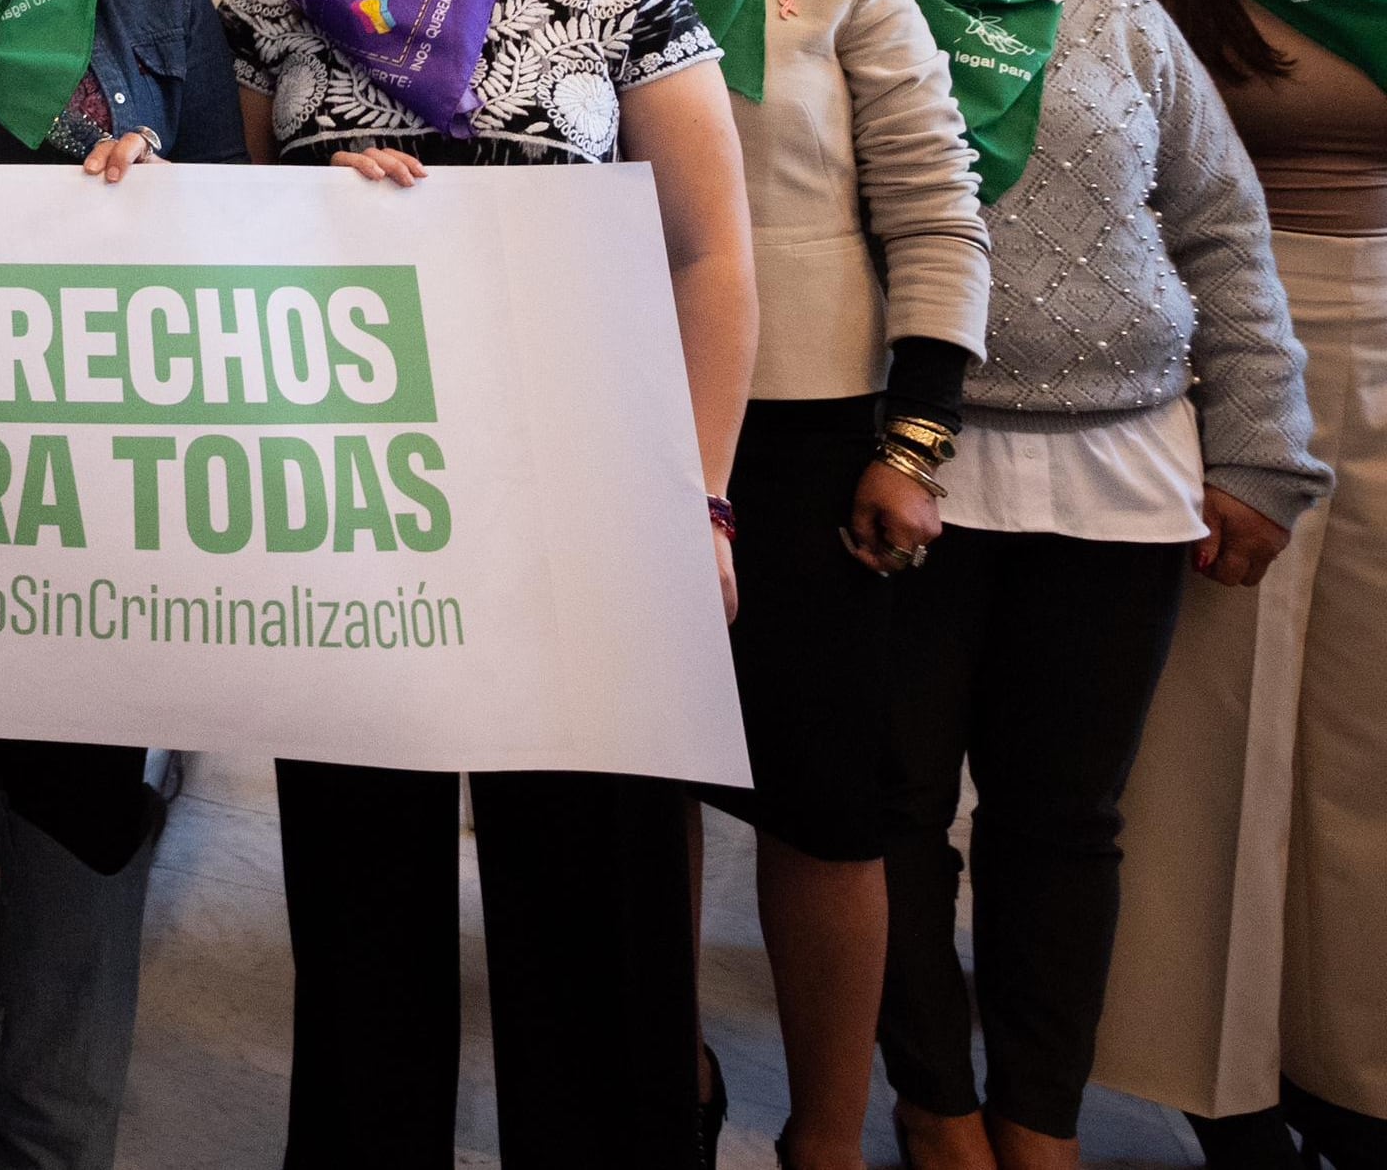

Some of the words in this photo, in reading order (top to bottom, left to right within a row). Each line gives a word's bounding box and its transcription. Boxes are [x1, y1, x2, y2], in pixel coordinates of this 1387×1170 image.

[954, 50, 996, 68] legal
[998, 62, 1033, 82] para
[112, 431, 453, 556] TODAS
